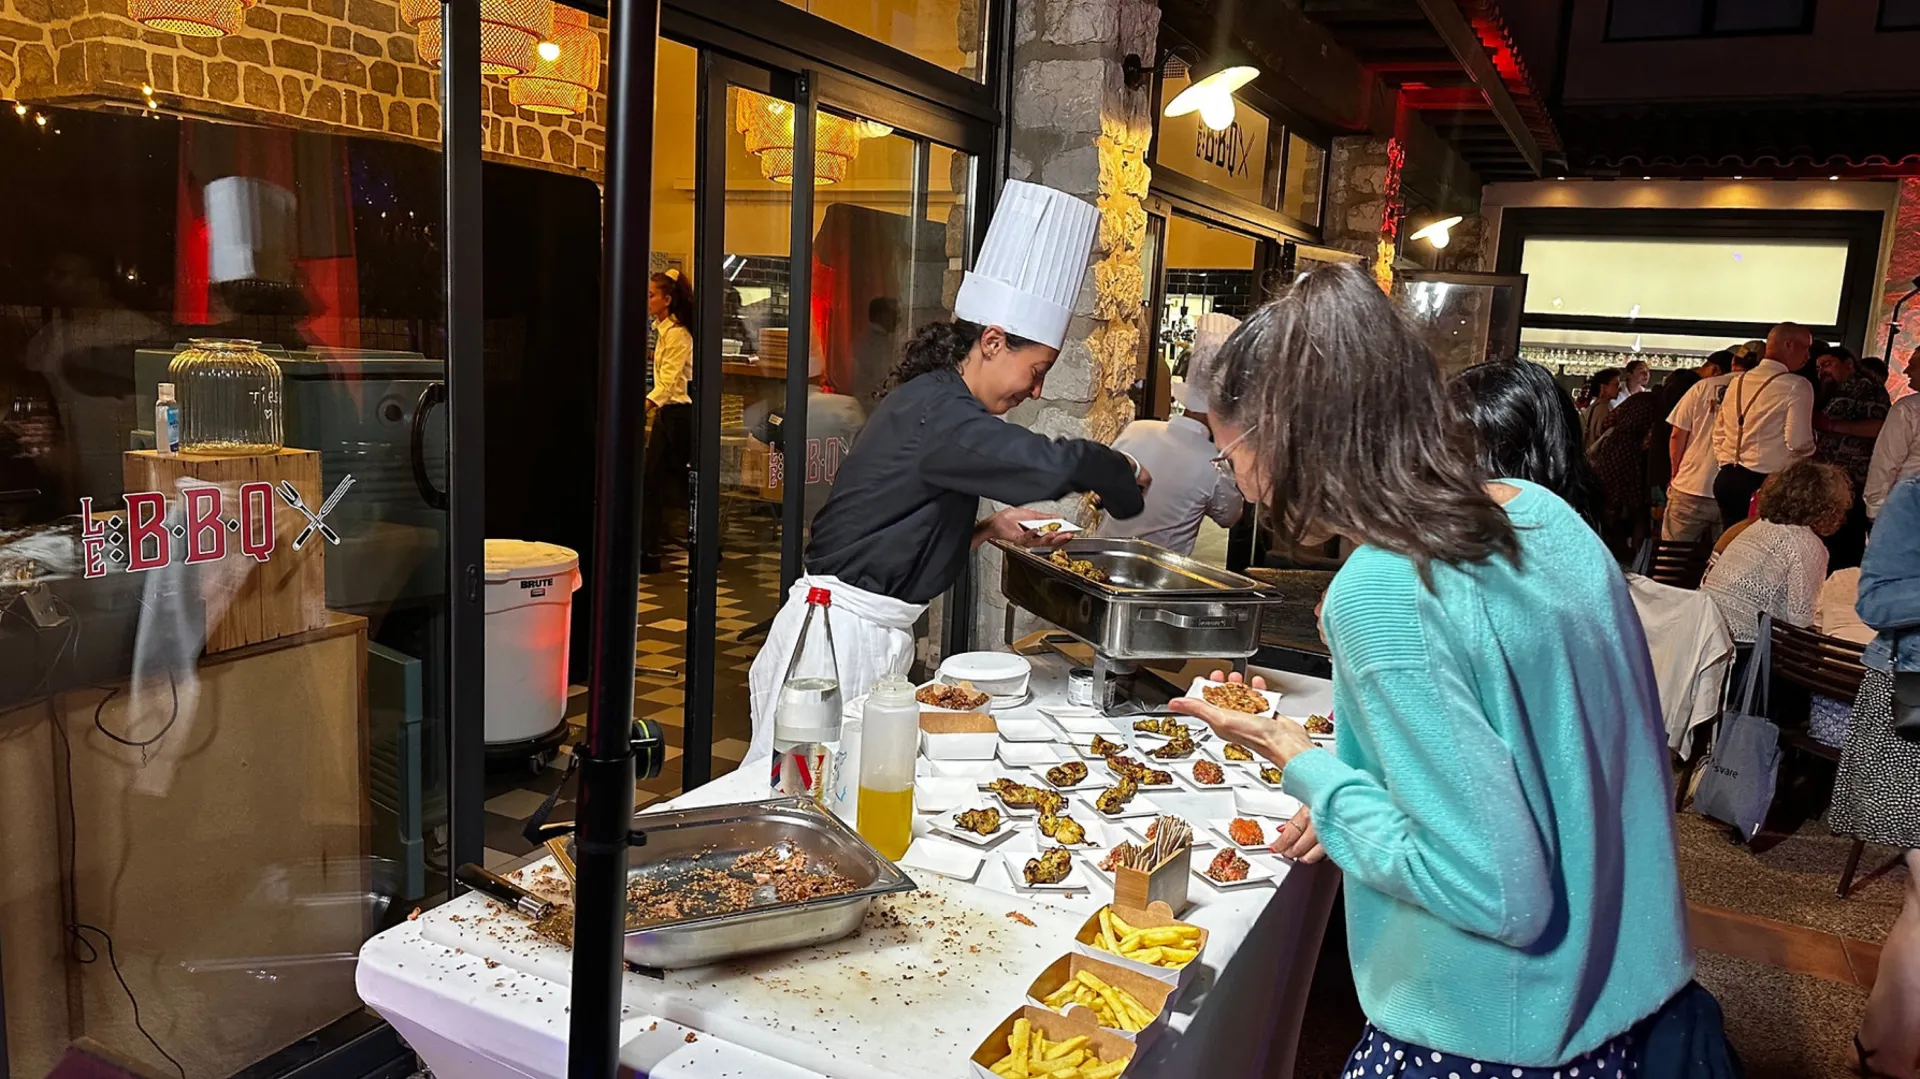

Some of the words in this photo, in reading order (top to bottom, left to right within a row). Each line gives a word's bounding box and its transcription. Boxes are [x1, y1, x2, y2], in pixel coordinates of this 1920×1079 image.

[796, 436, 840, 486] BQ
[520, 578, 553, 589] BRUTE
[1711, 764, 1739, 779] svare
